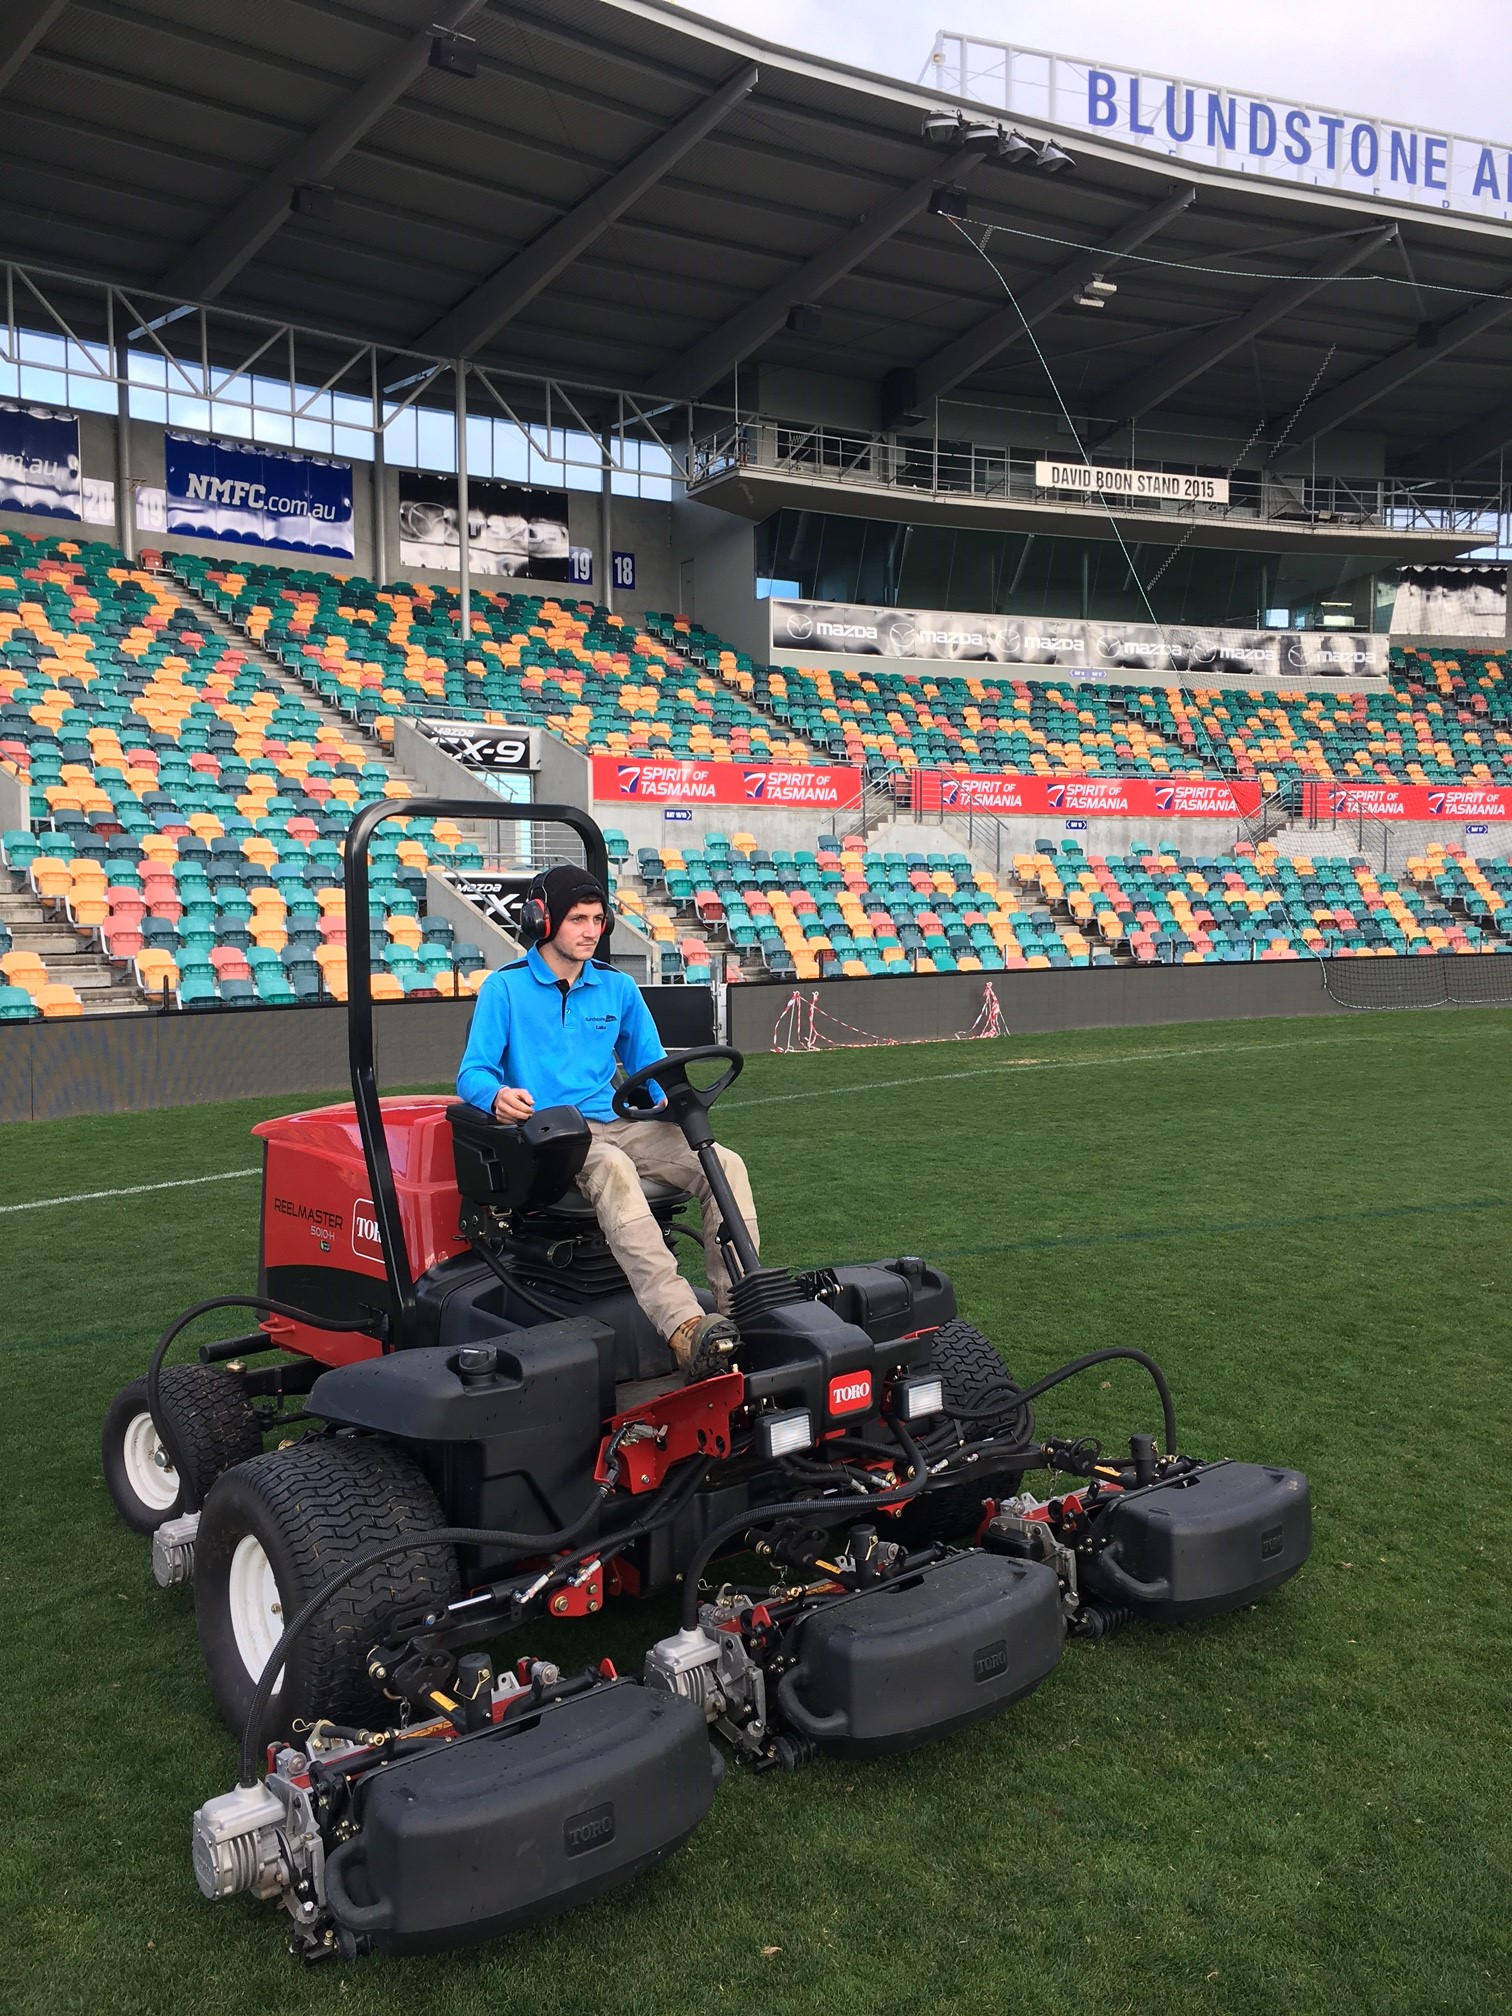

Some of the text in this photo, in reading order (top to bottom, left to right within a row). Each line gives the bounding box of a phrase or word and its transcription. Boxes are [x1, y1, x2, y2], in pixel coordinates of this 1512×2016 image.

[1088, 70, 1512, 203] BLUNDSTONE A
[0, 453, 58, 477] m.au
[1052, 466, 1214, 498] DAVID BOON STAND 2015
[83, 485, 113, 519] 20
[186, 473, 335, 520] NMFC.com.au
[139, 493, 163, 527] 19
[571, 550, 590, 580] 19
[614, 556, 633, 585] 18
[641, 766, 709, 781] SPIRIT OF
[767, 772, 831, 786] SPIRIT OF
[640, 782, 716, 797] TASMANIA
[766, 787, 838, 801] TASMANIA
[960, 780, 1016, 793] SPIRIT OF
[1067, 784, 1122, 796] SPIRIT OF
[1175, 786, 1230, 798] SPIRIT OF
[960, 794, 1022, 807] TASMANIA
[1066, 797, 1128, 809] TASMANIA
[1347, 790, 1399, 802] SPIRIT OF
[1446, 792, 1499, 803] SPIRIT OF
[1174, 799, 1237, 811] TASMANIA
[1346, 802, 1404, 814] TASMANIA
[1445, 804, 1505, 815] TASMANIA
[274, 1198, 344, 1231] REELMASTER
[833, 1382, 870, 1404] TORO
[976, 1651, 1006, 1674] TORO
[569, 1816, 612, 1846] TORO
